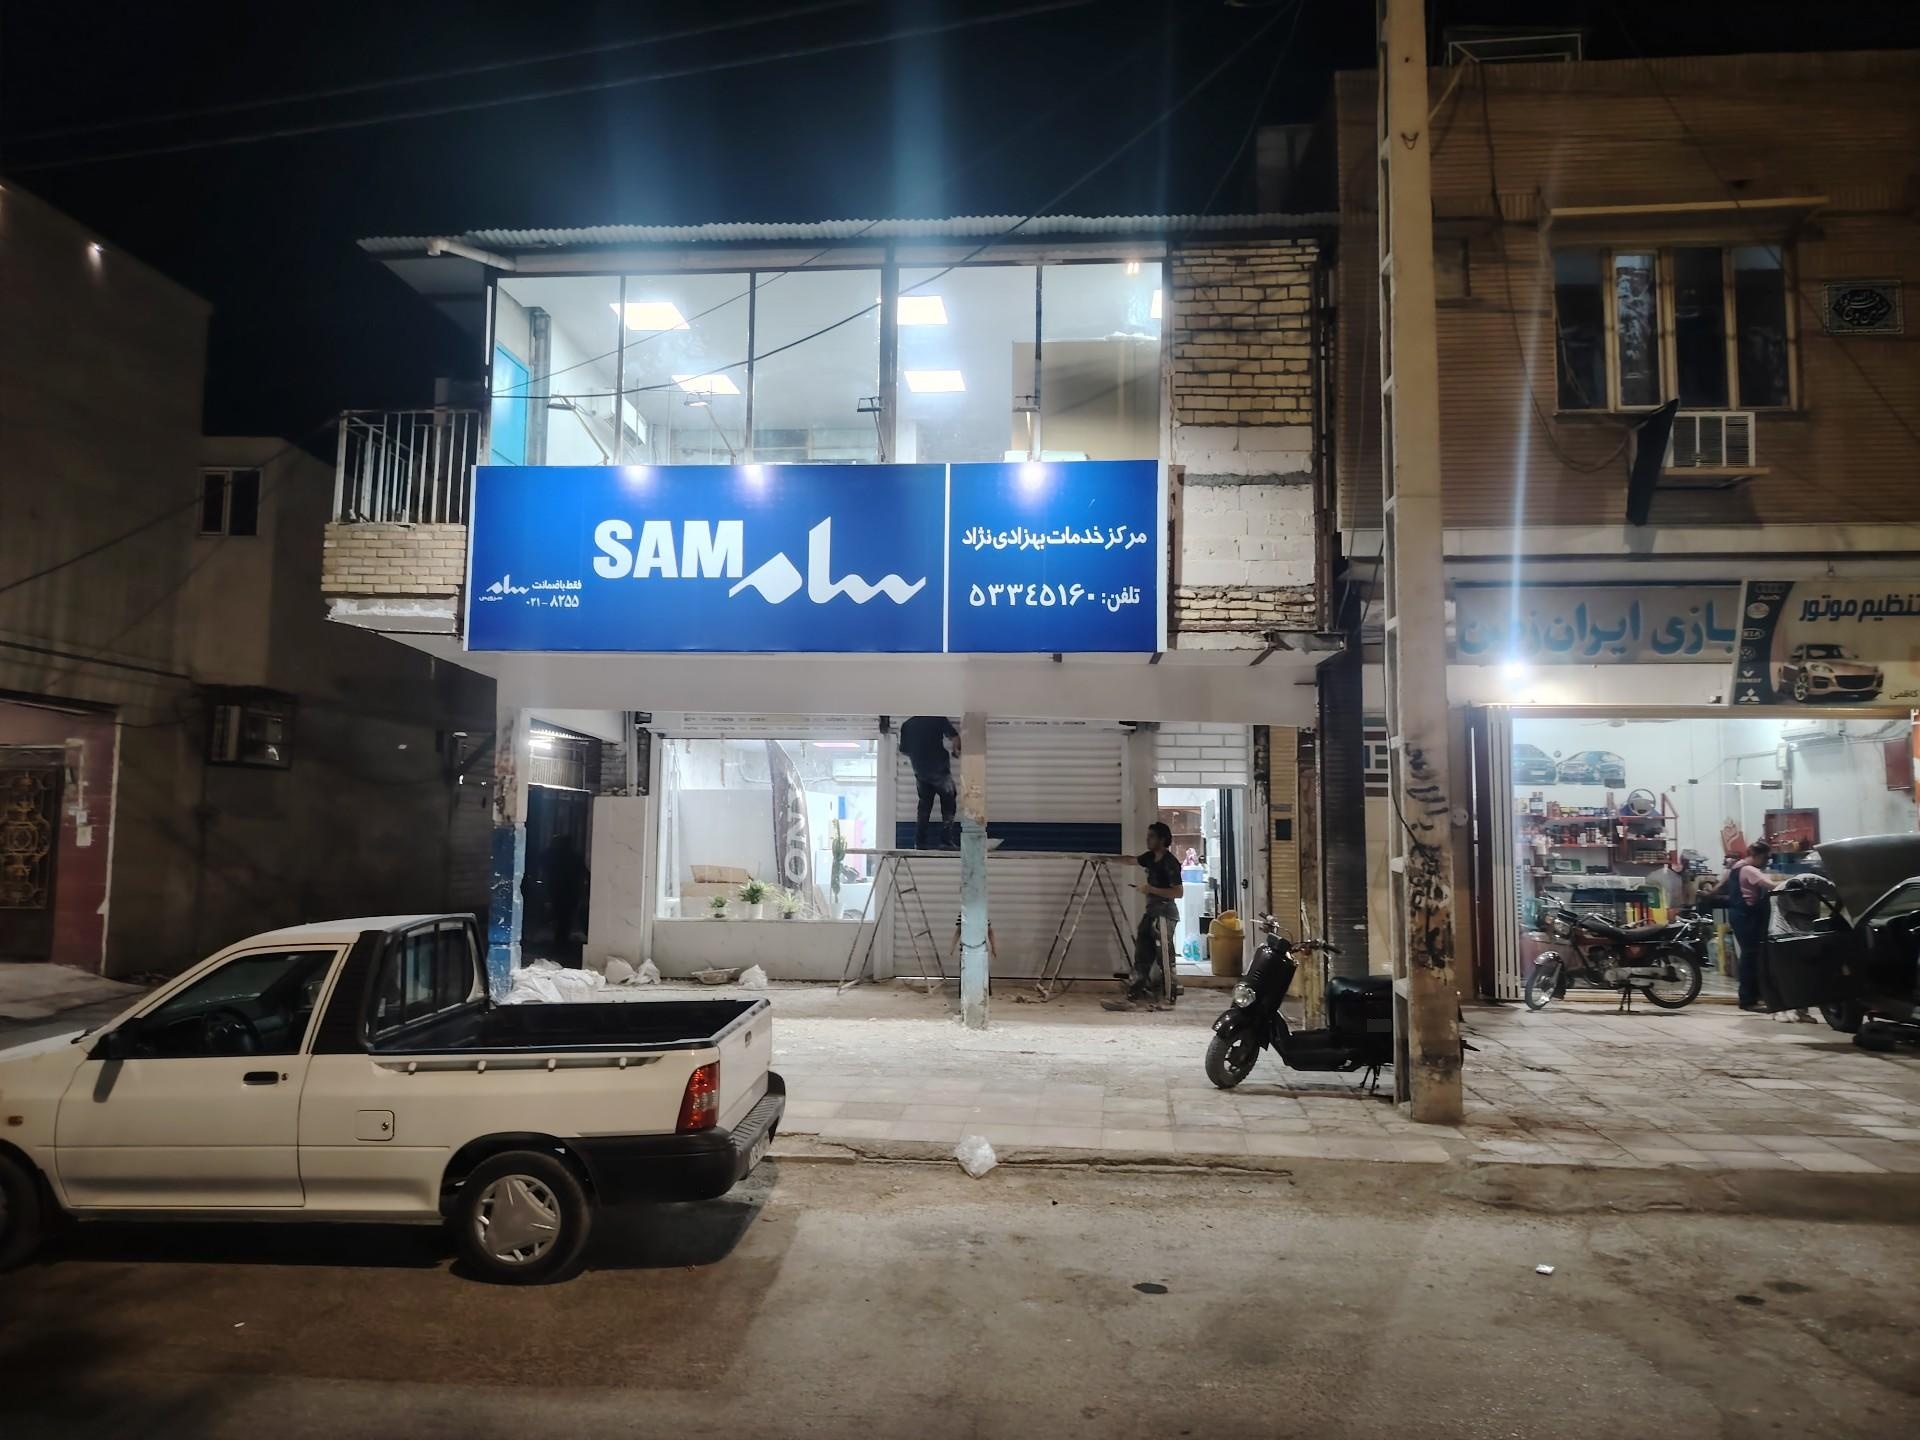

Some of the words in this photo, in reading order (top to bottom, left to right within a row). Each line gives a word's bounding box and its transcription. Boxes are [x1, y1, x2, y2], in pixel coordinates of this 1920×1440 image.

[593, 519, 744, 579] SAM
[1046, 525, 1105, 545] خدمات
[1104, 525, 1147, 550] مرکز
[729, 516, 926, 605] سام
[486, 574, 530, 595] سام
[1798, 594, 1858, 622] موتور
[1857, 593, 1920, 623] نظیم
[1543, 599, 1642, 657] ایران
